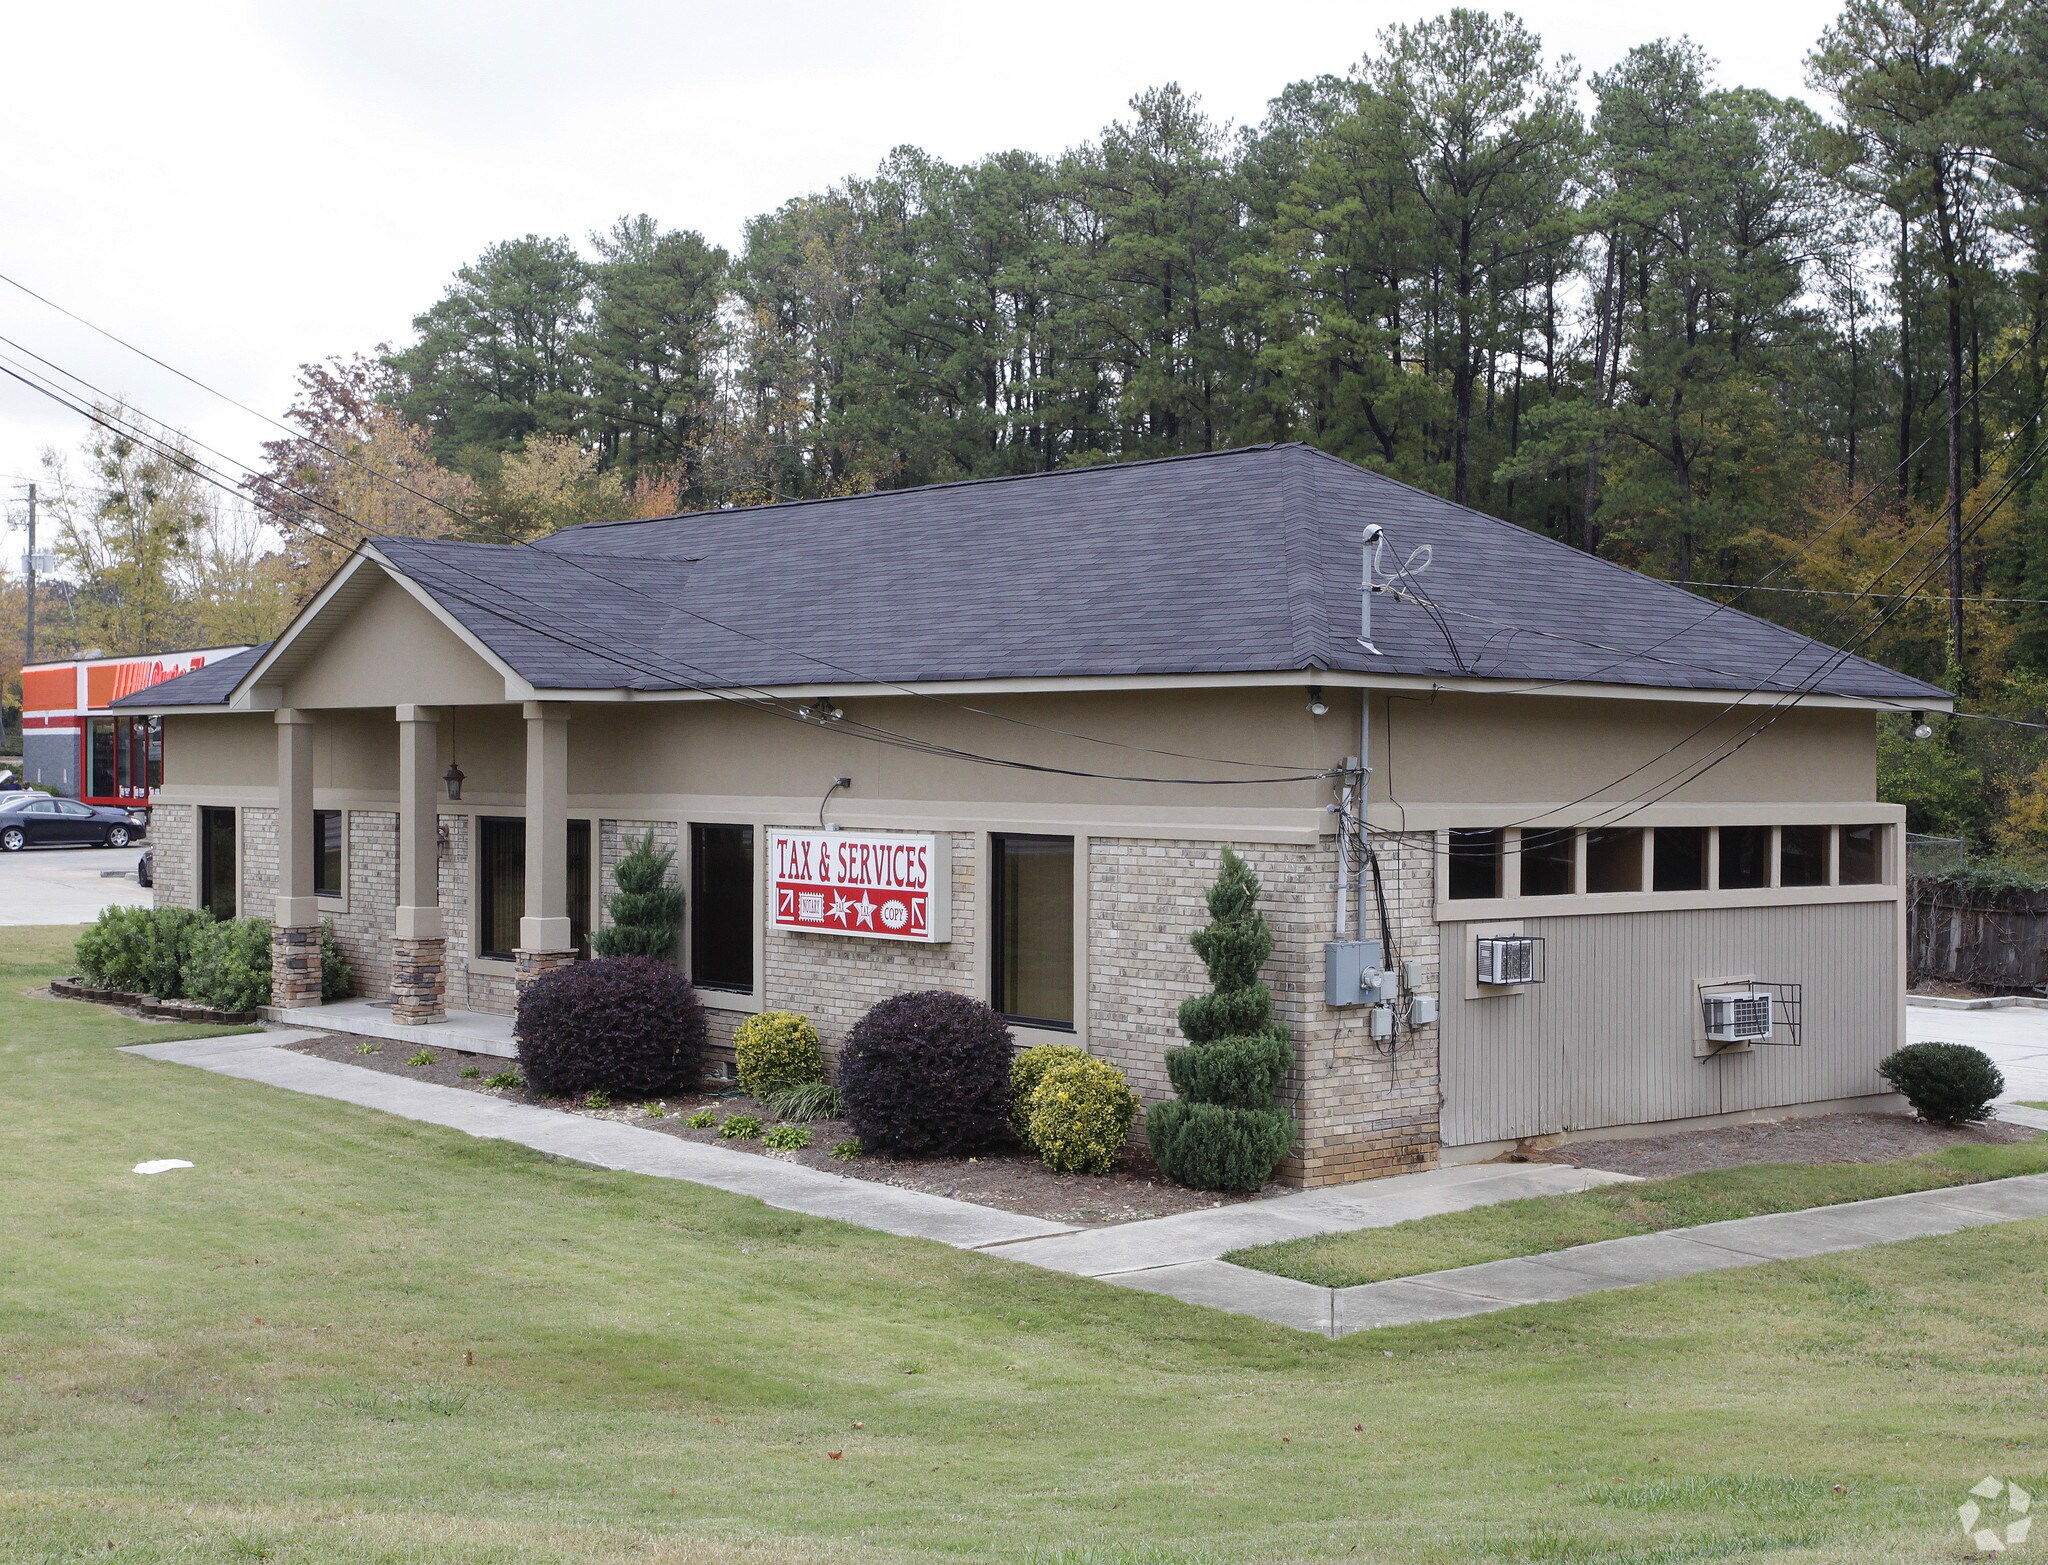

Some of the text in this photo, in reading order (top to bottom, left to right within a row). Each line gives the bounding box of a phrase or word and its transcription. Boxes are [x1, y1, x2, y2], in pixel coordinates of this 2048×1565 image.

[777, 838, 928, 889] TAX & SERVICES
[802, 898, 820, 914] NOTARY
[884, 907, 904, 921] COPY
